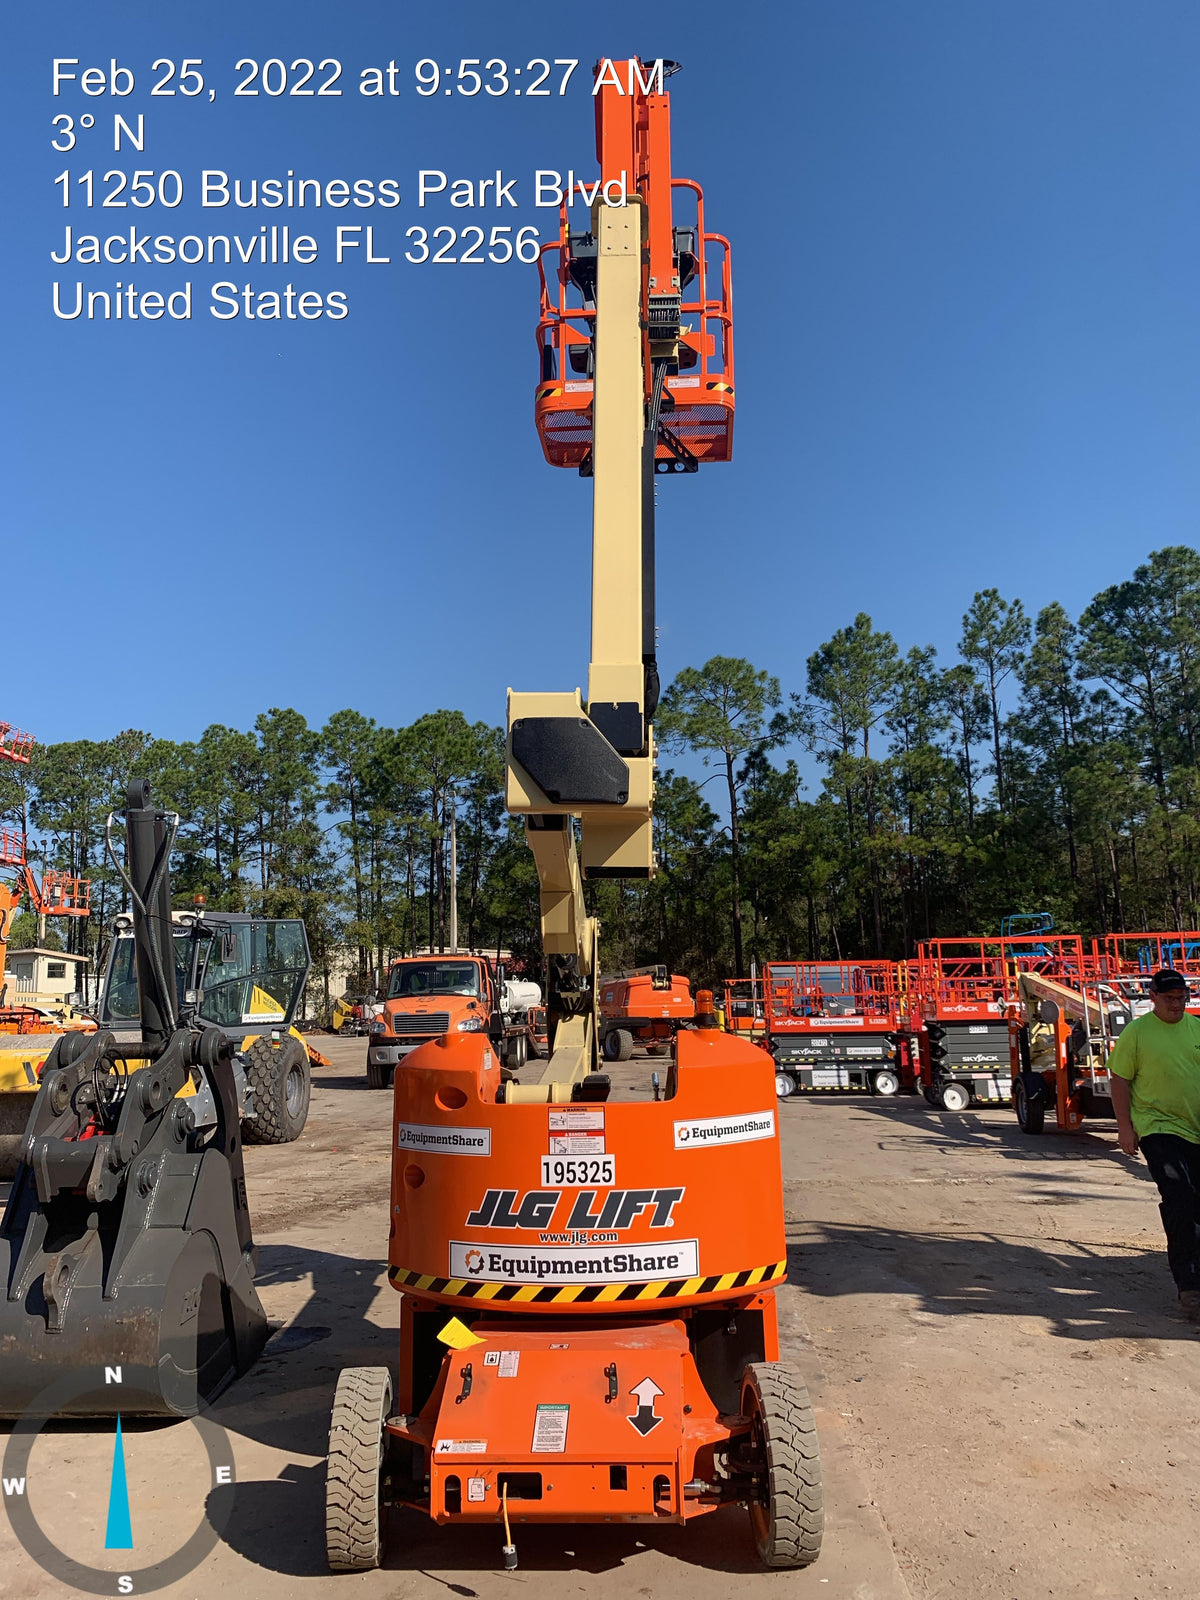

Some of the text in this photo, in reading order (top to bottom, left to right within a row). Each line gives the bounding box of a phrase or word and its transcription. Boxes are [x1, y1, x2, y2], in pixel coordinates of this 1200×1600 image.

[942, 1005, 979, 1013] SKYJACK
[819, 1018, 860, 1026] EquipmentShare
[962, 1054, 999, 1062] SKYJACK
[692, 1119, 771, 1139] EquipmentShare
[407, 1131, 484, 1147] EquipmentShare
[543, 1160, 613, 1184] 195325
[466, 1187, 686, 1230] JLG LIFT
[539, 1231, 618, 1245] www.jlg.com
[488, 1253, 679, 1278] EquipmentShare
